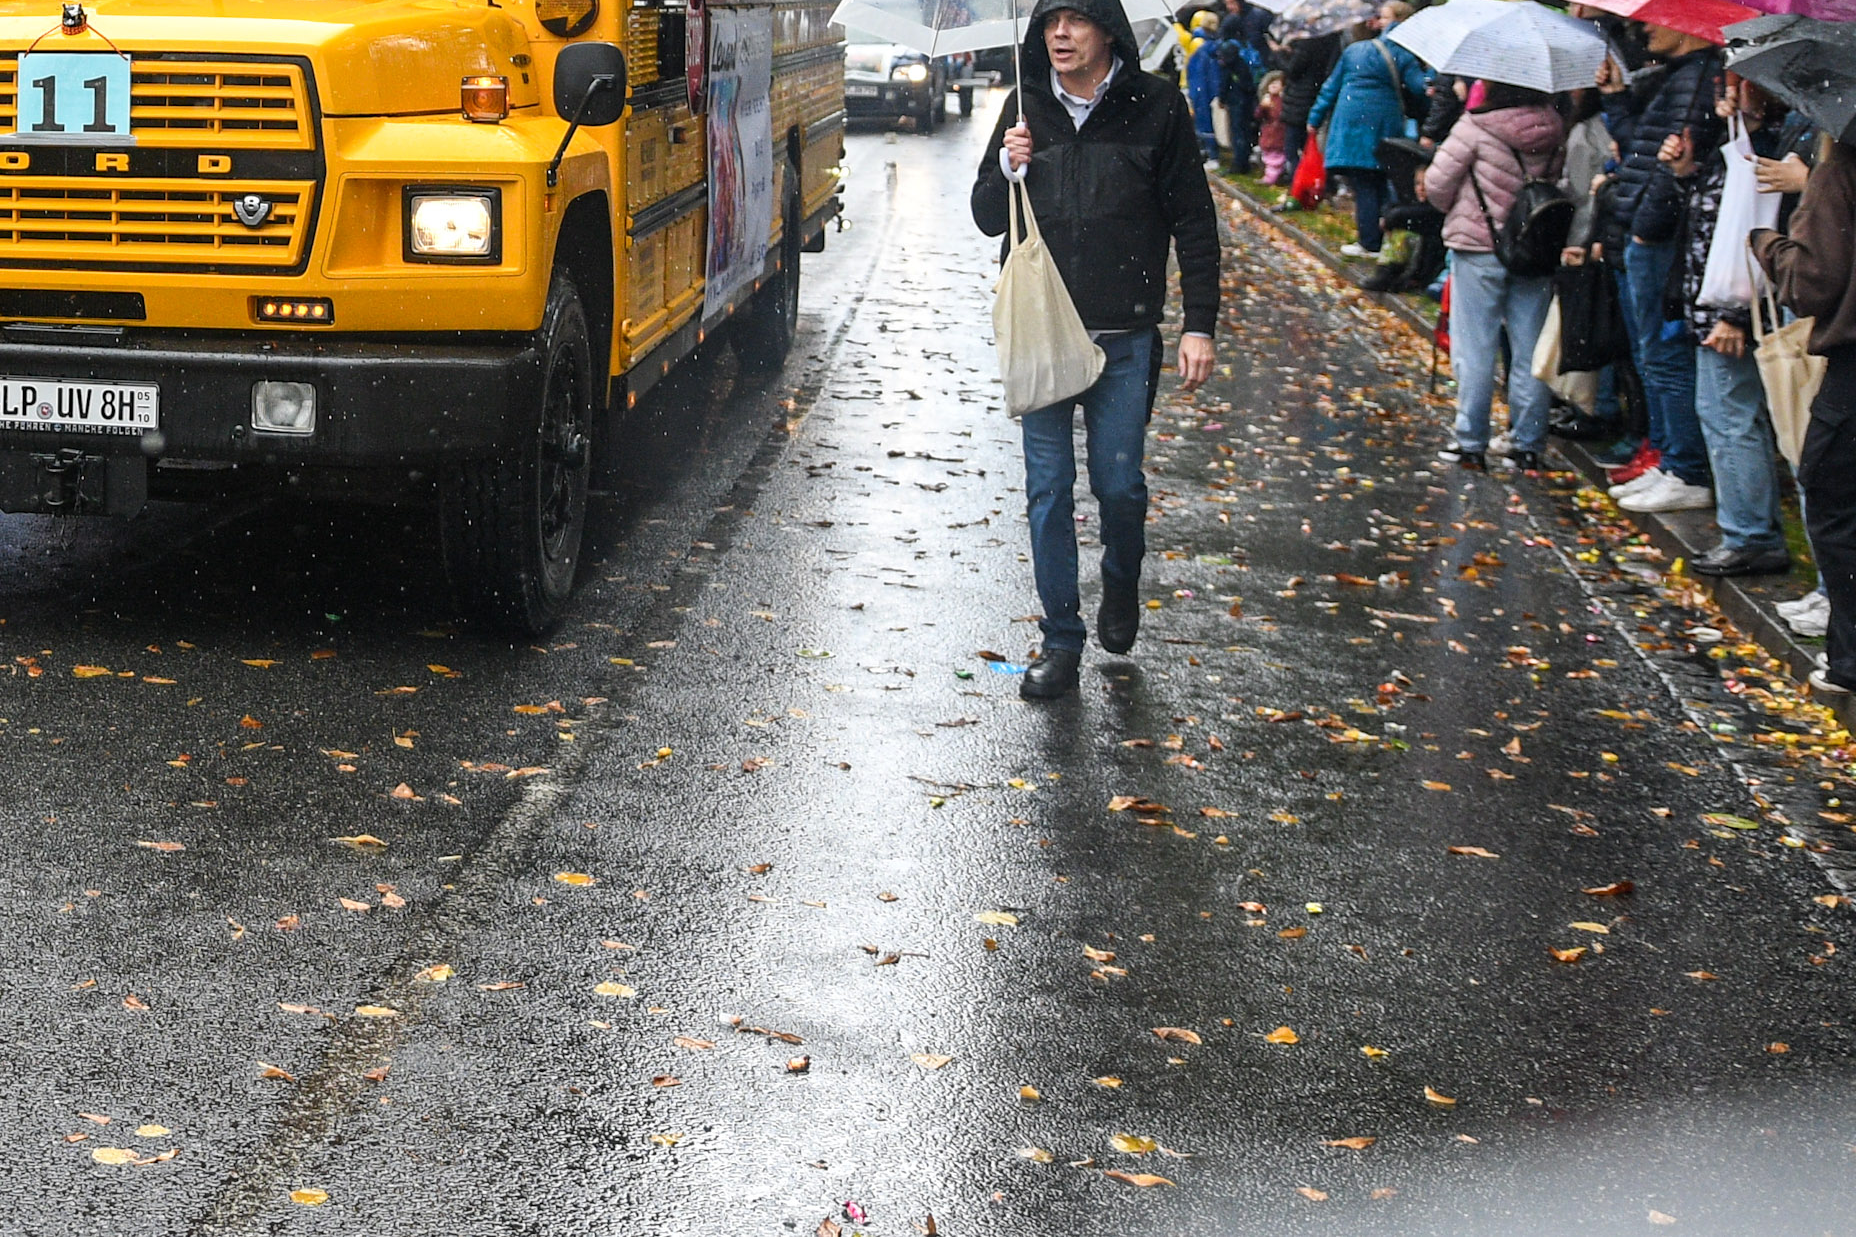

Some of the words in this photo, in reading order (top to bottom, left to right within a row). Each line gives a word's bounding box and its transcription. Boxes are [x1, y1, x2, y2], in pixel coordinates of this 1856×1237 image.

[32, 74, 117, 133] 11
[137, 391, 151, 401] 05
[57, 387, 93, 419] UV
[101, 389, 135, 422] 8H
[137, 413, 150, 423] 10
[64, 423, 103, 434] MANCHE
[106, 425, 144, 436] FOLGEN
